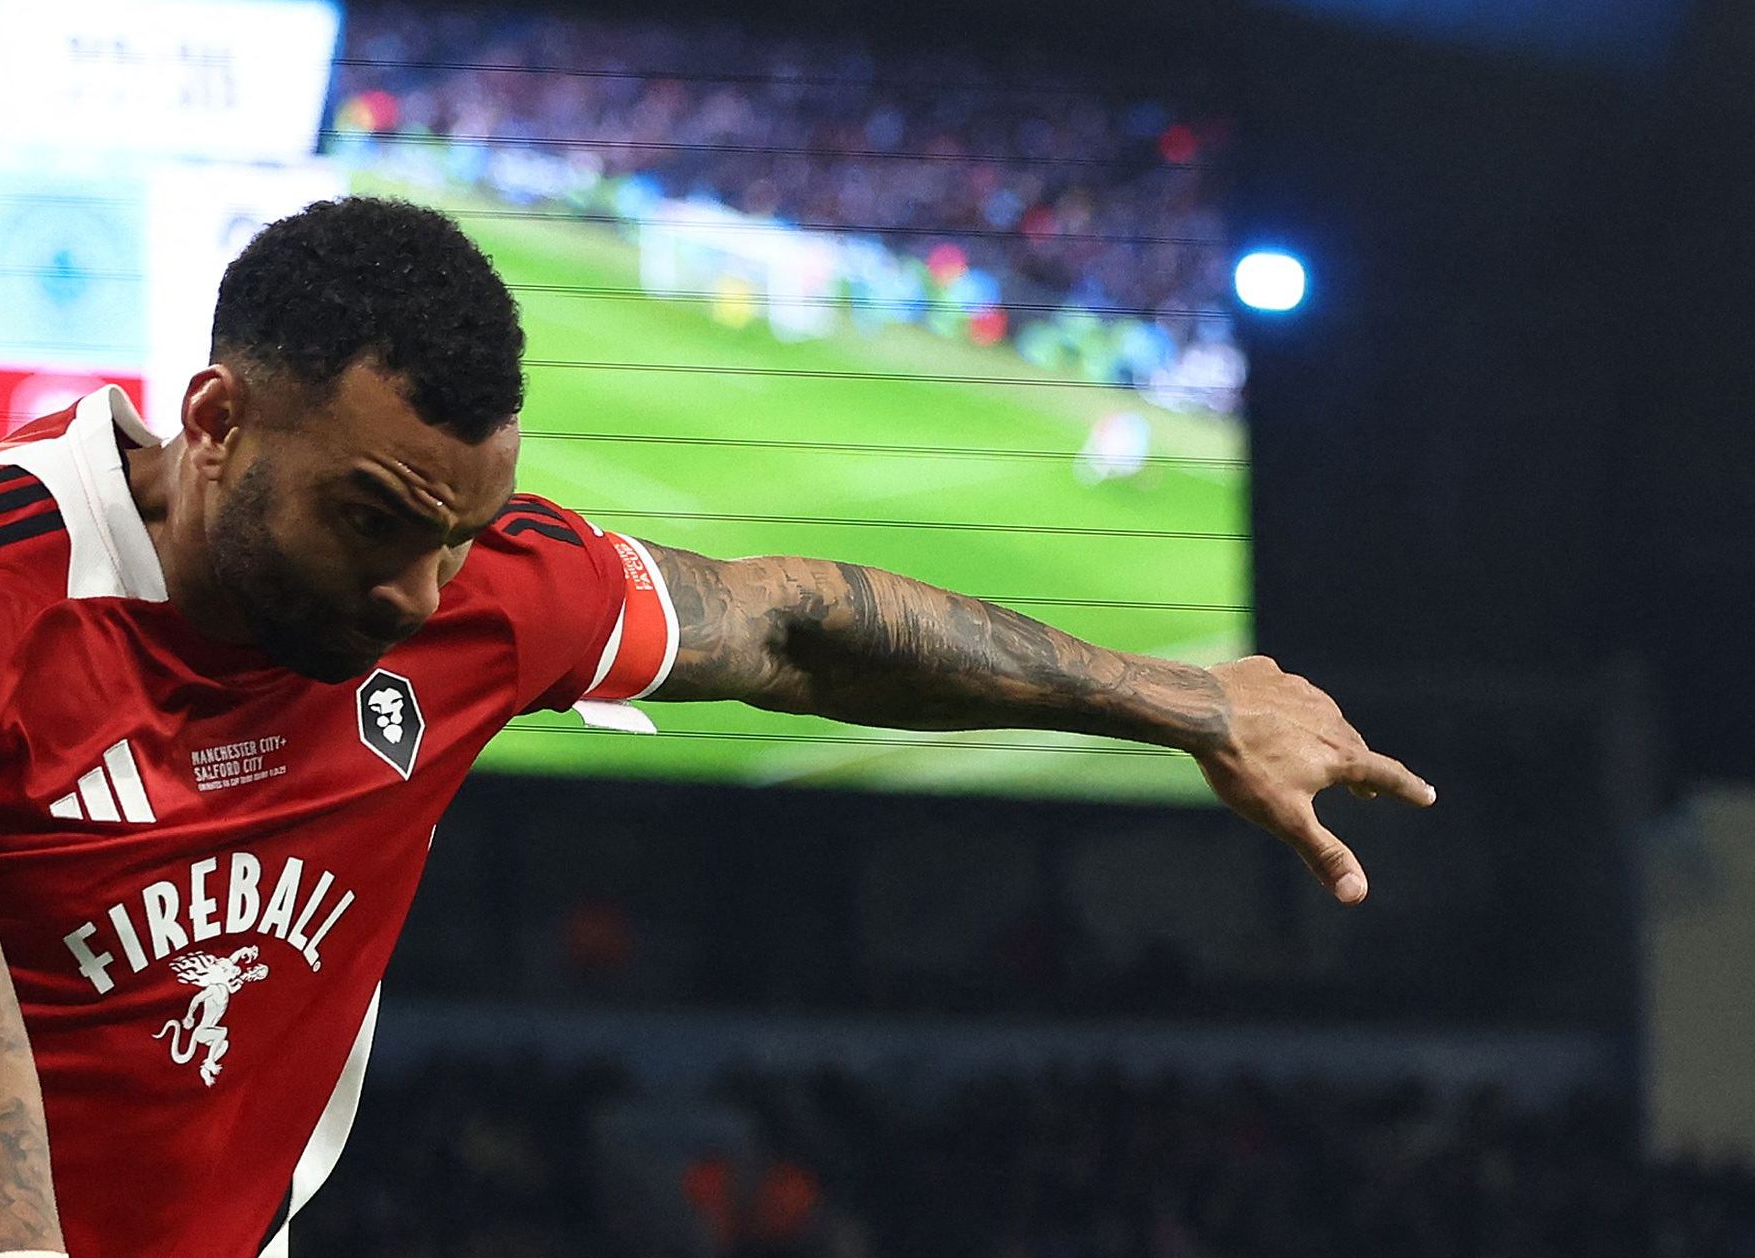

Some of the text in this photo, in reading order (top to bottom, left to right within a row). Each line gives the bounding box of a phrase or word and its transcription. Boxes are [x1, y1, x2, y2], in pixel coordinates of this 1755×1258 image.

[191, 741, 257, 766] MANCHESTER
[194, 760, 240, 782] SALFORD
[243, 756, 263, 773] CITY
[63, 852, 355, 995] FIREBALL
